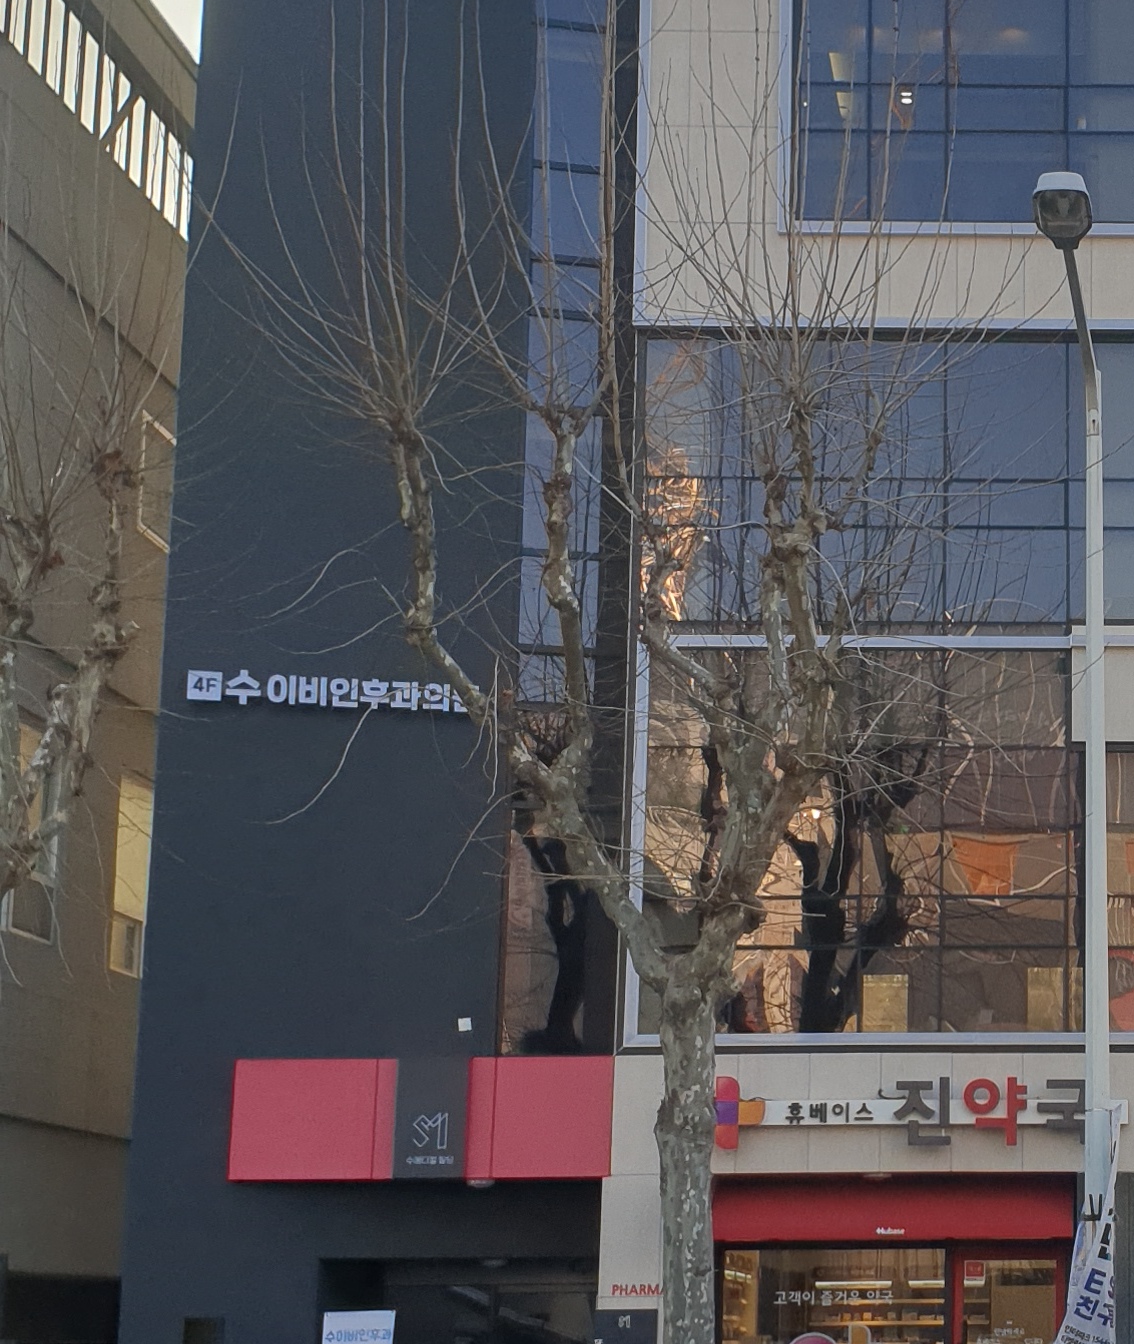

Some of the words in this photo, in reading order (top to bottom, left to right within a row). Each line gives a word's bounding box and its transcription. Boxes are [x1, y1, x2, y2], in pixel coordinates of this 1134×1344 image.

[192, 676, 218, 693] 4F
[785, 1102, 875, 1125] 휴베이스
[773, 1290, 816, 1306] 고객이
